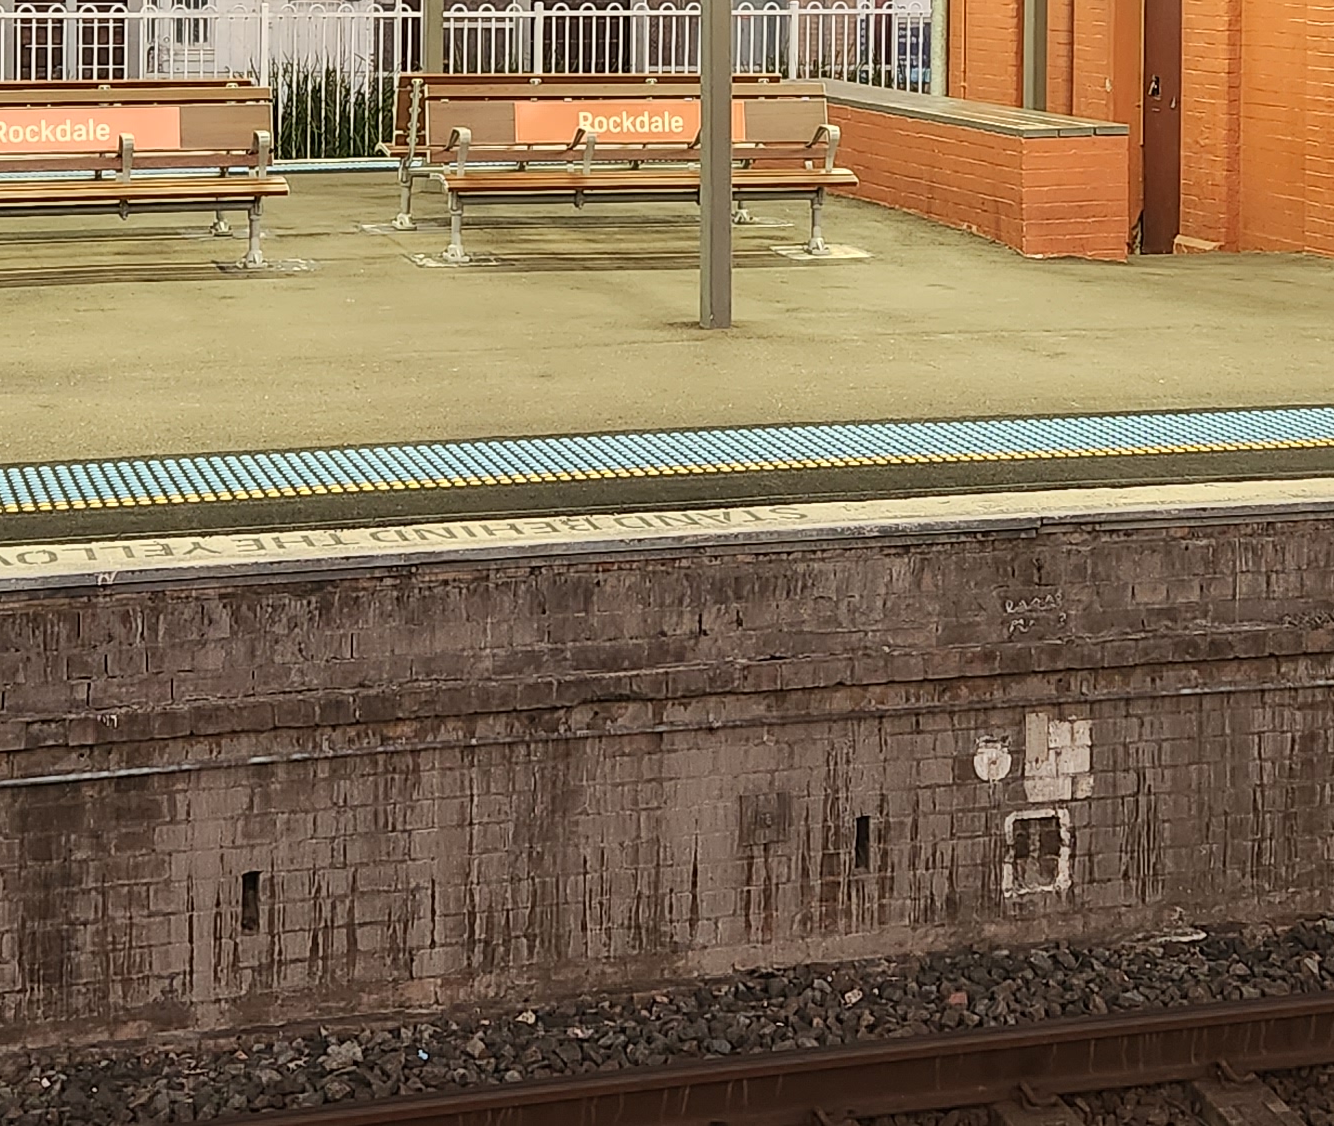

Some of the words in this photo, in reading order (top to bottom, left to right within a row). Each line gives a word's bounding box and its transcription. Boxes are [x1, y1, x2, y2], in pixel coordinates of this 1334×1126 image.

[578, 111, 684, 133] Rockdale
[369, 516, 602, 542] BEHIND
[615, 507, 808, 529] STAND
[230, 532, 360, 553] THE
